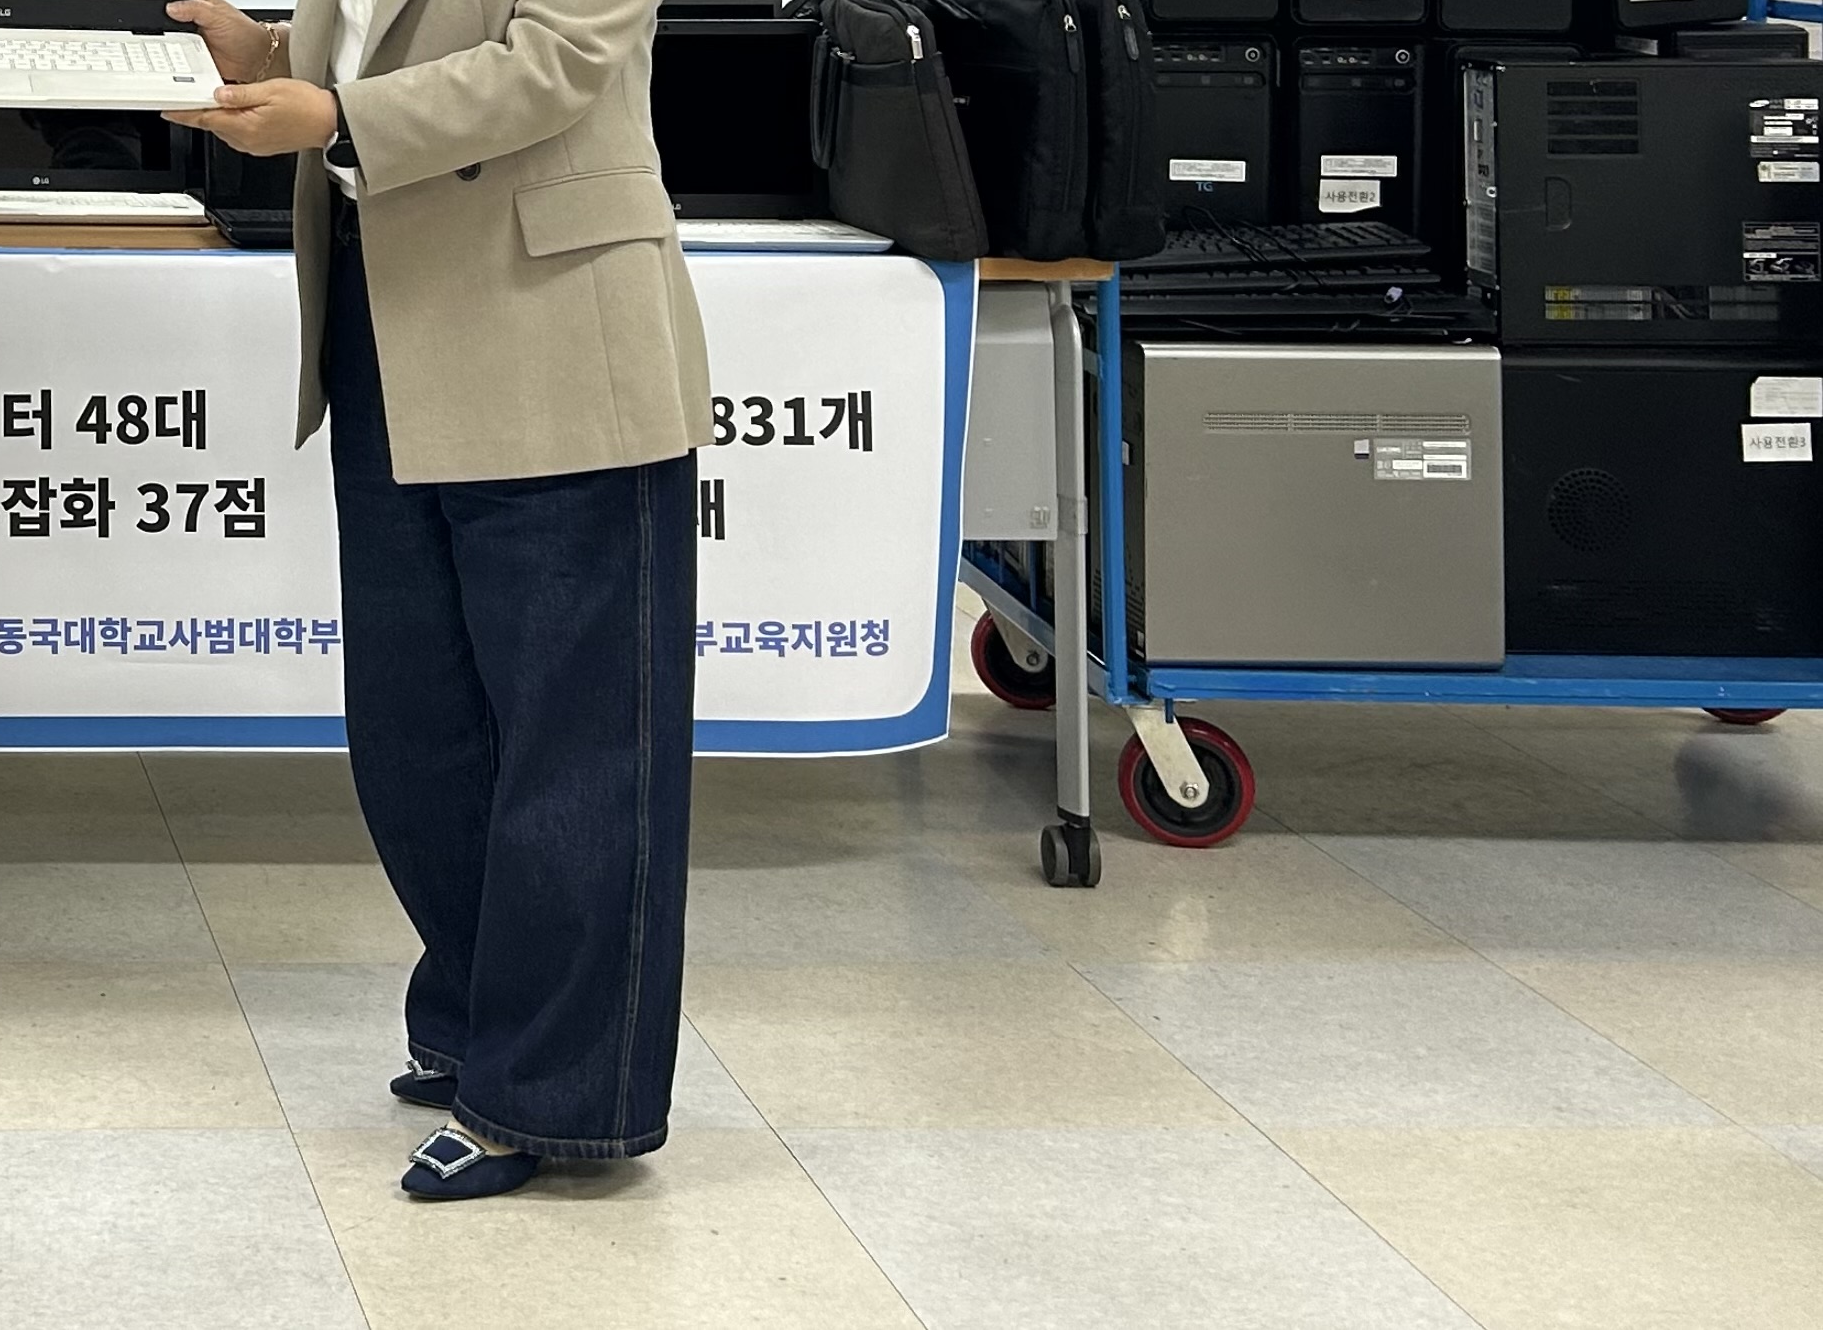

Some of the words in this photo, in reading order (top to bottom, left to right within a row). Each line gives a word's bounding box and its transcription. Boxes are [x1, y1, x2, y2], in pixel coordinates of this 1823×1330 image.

[1196, 181, 1214, 192] TG
[75, 389, 207, 451] 48대
[135, 477, 266, 539] 37점
